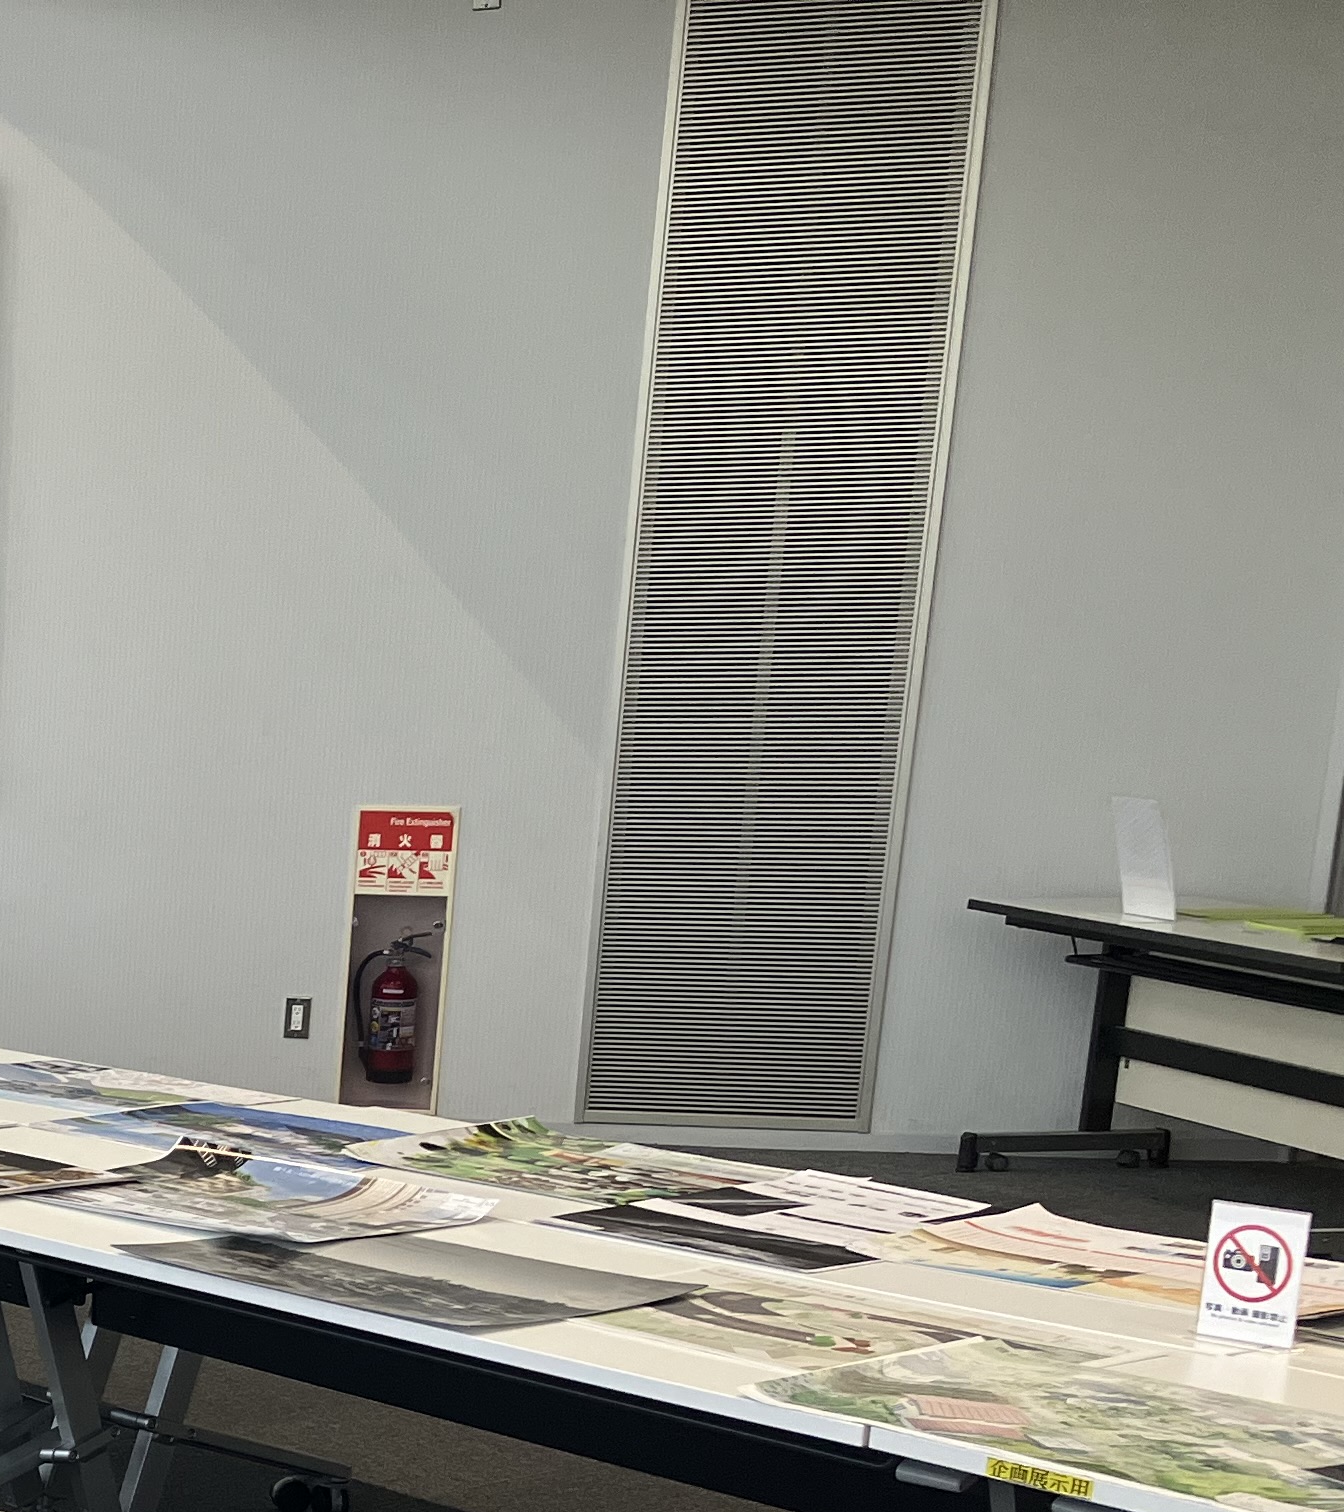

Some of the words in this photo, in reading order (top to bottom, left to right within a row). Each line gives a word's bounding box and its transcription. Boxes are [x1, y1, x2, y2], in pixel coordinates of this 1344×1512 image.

[990, 1459, 1089, 1497] 企画展示用
